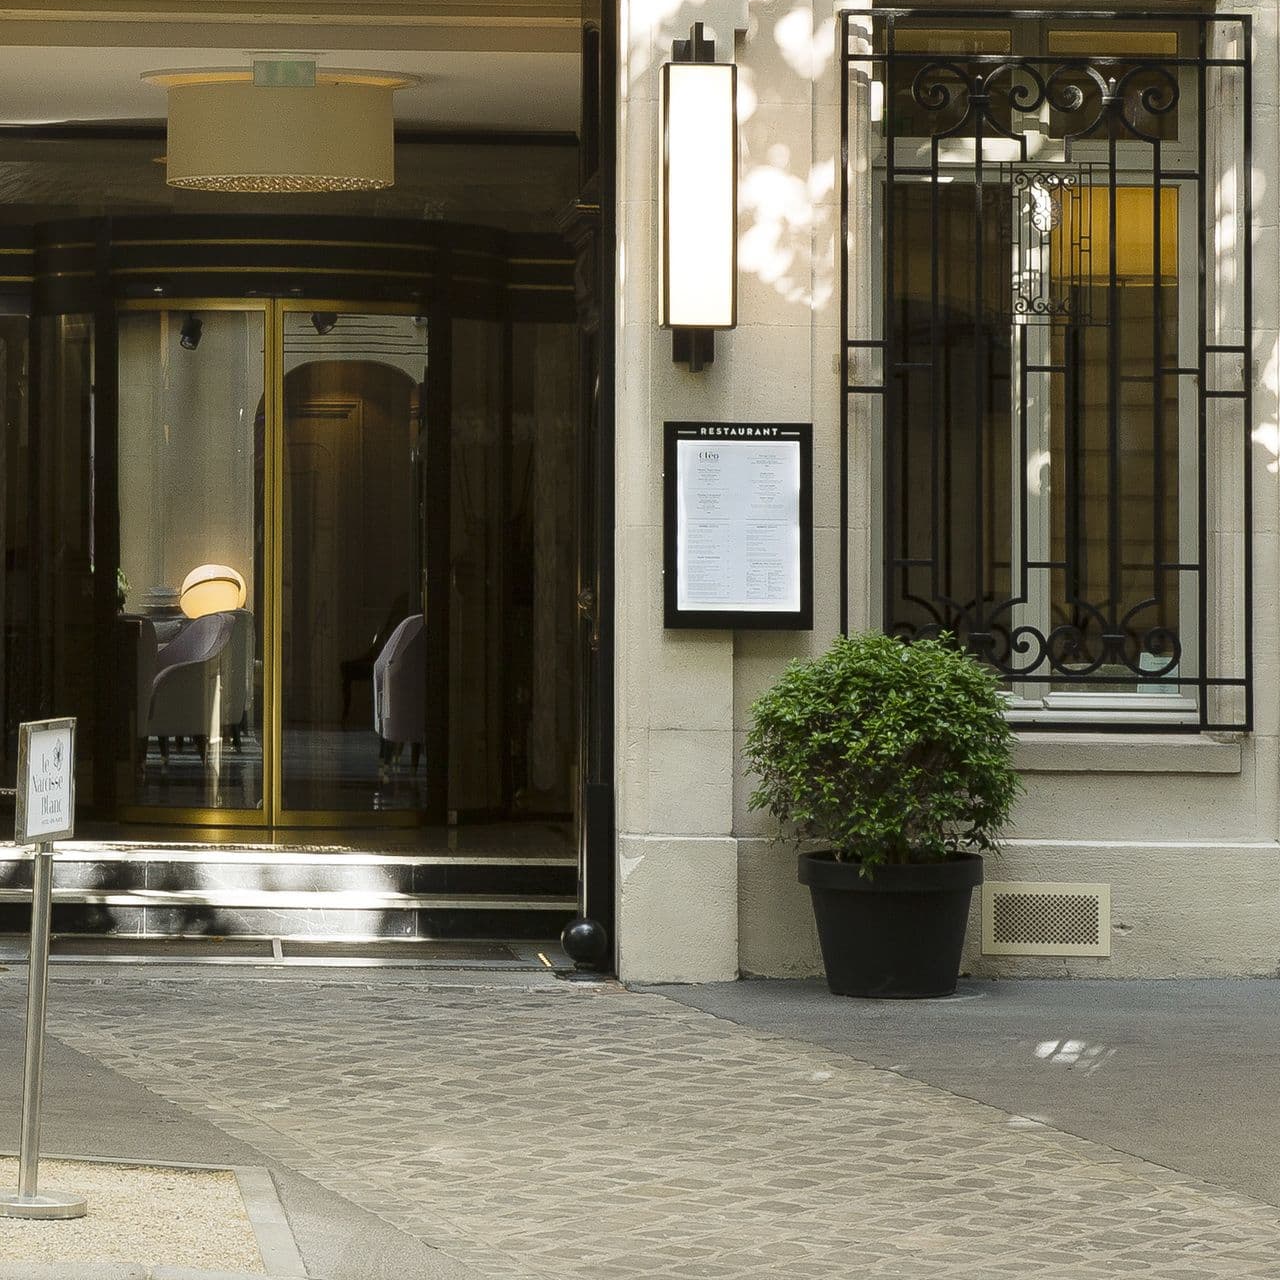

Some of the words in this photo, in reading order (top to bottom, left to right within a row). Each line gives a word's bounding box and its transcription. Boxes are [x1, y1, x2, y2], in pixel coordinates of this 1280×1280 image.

[700, 426, 779, 436] RESTAURANT
[32, 771, 64, 794] Narcisse
[41, 794, 62, 816] Blanc
